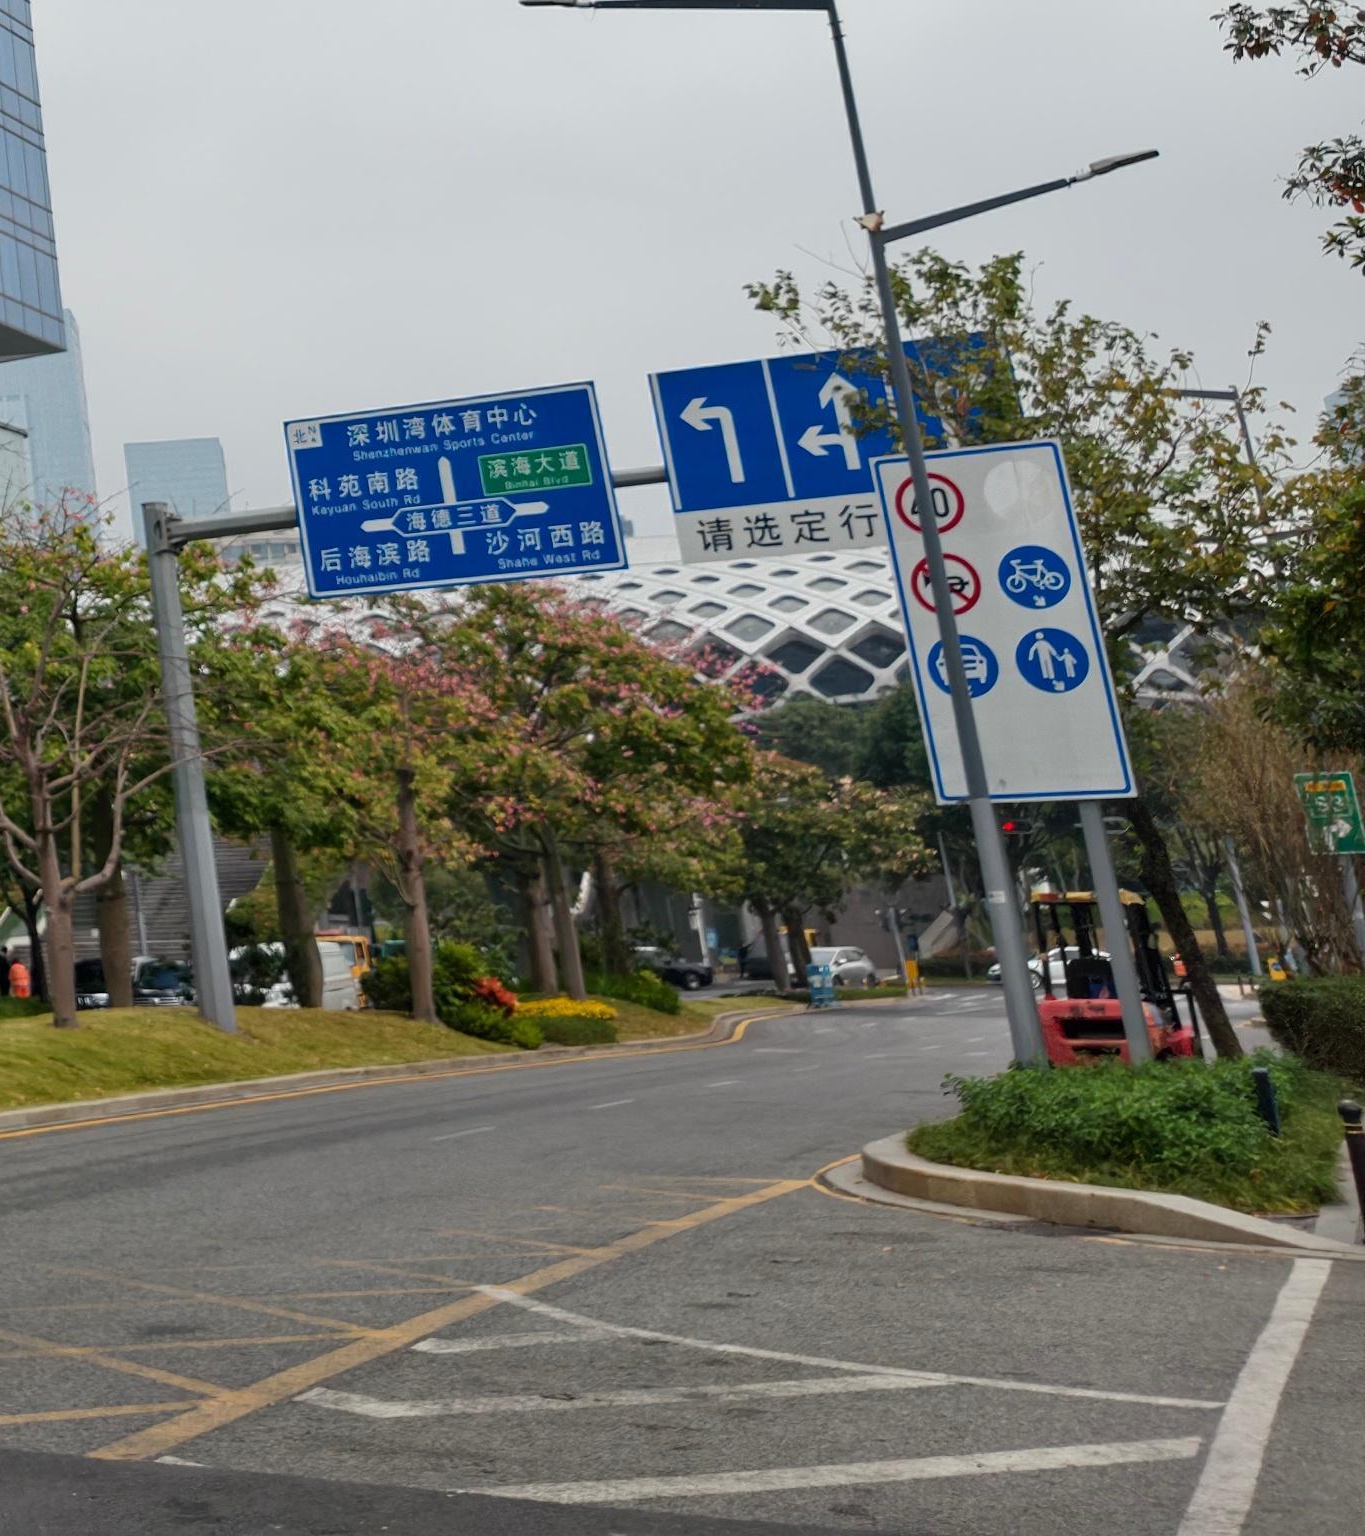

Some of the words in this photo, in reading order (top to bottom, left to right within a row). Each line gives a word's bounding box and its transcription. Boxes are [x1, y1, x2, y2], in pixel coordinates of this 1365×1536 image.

[293, 429, 308, 444] 北
[308, 425, 317, 435] N
[346, 403, 537, 447] 深圳湾体育中心
[353, 442, 438, 461] Shenzhenwan
[443, 436, 485, 451] Sports
[490, 430, 534, 444] Center
[487, 450, 581, 480] 滨海大道
[308, 467, 419, 502] 科苑南路
[311, 502, 357, 517] Keyuan
[362, 496, 399, 511] South
[403, 494, 421, 505] Rd
[406, 503, 502, 531] 海德三道
[485, 520, 606, 555] 沙河西路
[320, 538, 431, 572] 后海滨路
[498, 557, 538, 569] Shahe
[542, 552, 577, 564] West
[581, 549, 601, 561] Rd
[336, 571, 398, 585] Houhaibin
[402, 567, 421, 579] Rd
